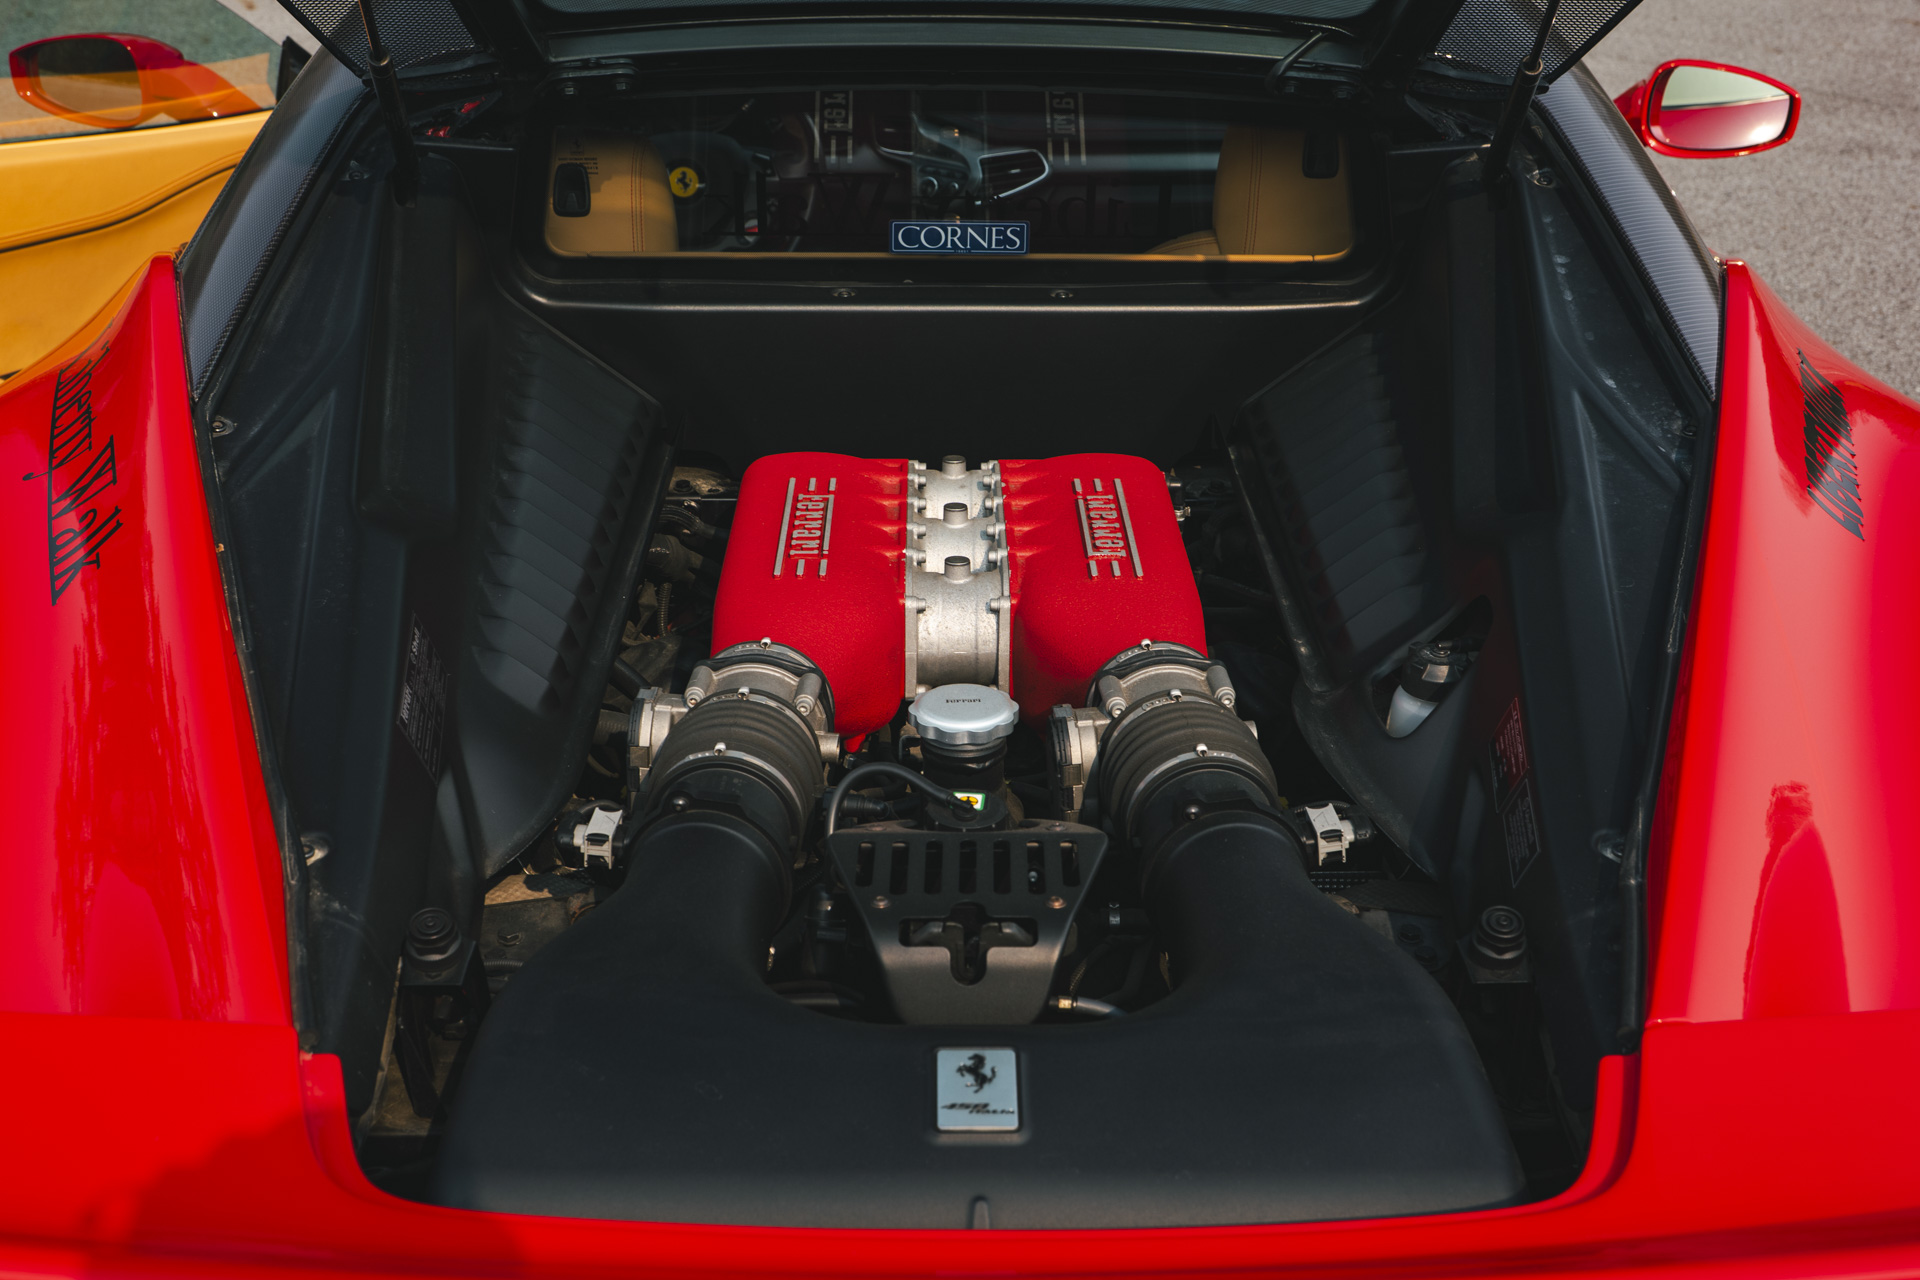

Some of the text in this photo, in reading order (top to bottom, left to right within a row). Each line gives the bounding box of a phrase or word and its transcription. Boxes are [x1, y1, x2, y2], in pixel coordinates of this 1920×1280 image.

[897, 225, 1021, 250] CORNES
[49, 434, 124, 606] Walk
[789, 493, 834, 556] Ferrari
[1077, 495, 1126, 557] Ferrari
